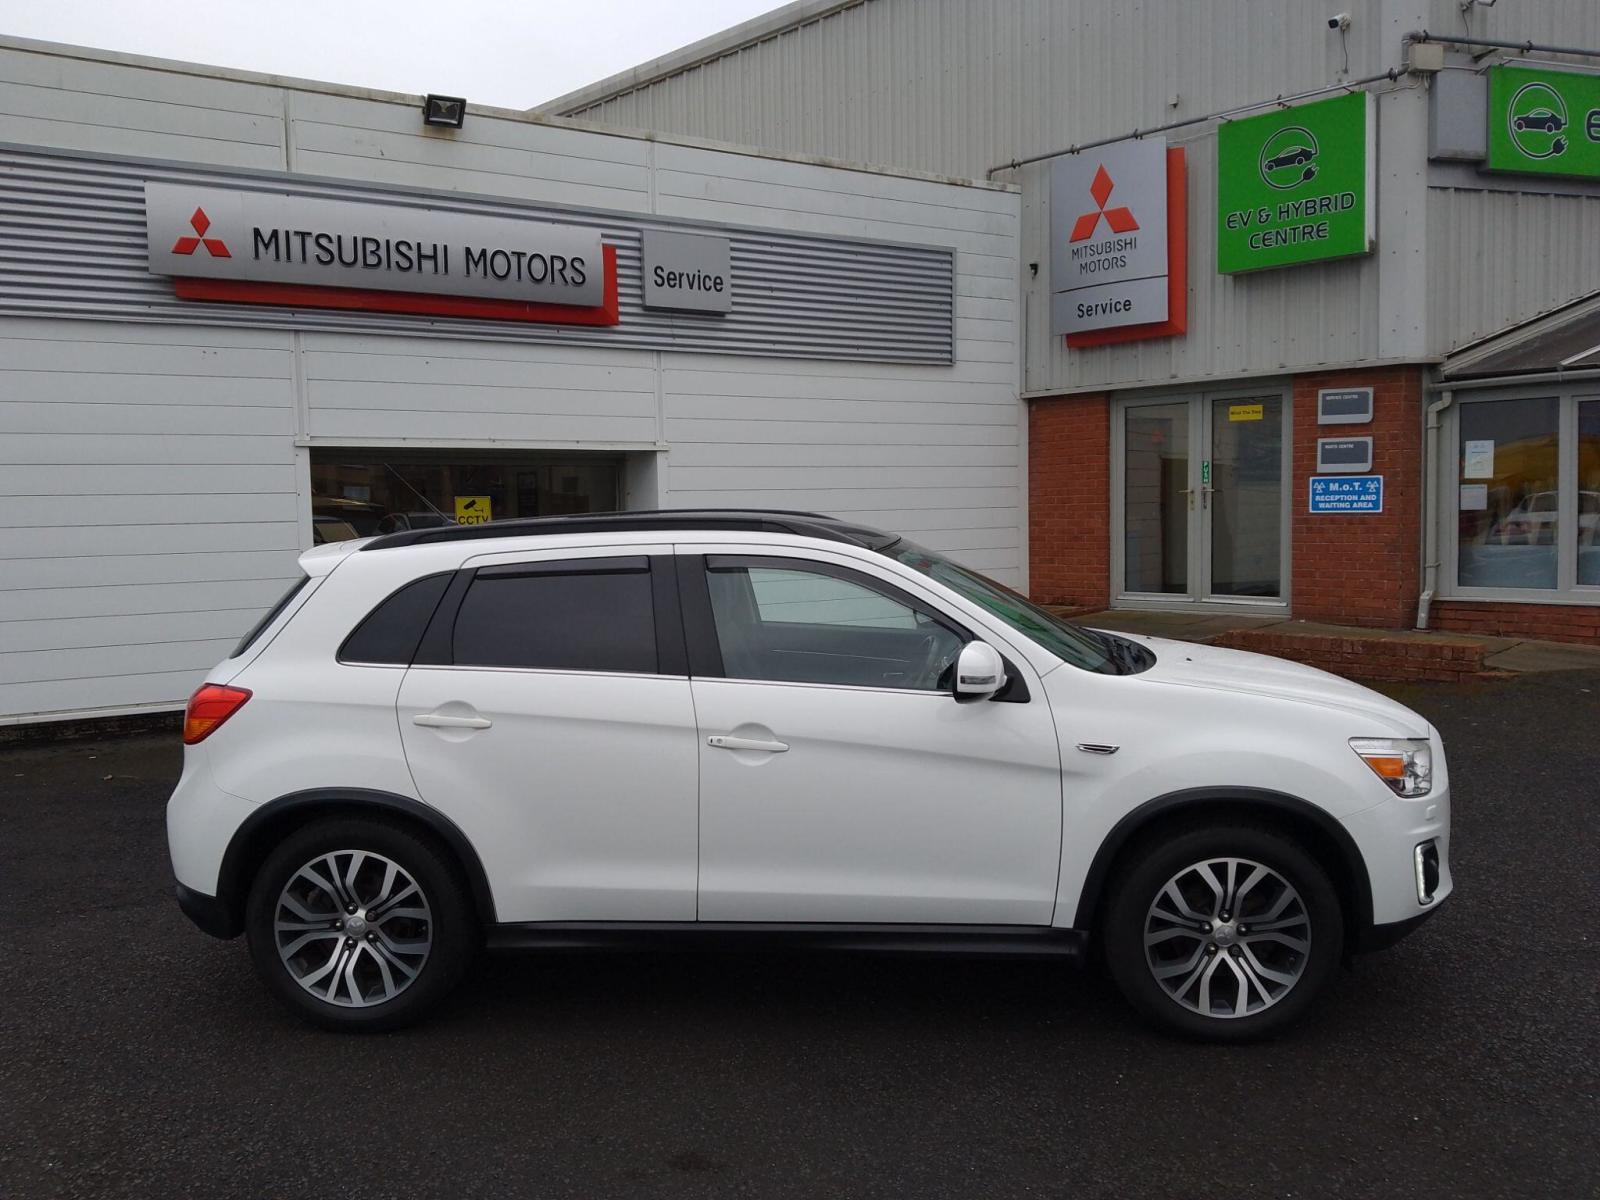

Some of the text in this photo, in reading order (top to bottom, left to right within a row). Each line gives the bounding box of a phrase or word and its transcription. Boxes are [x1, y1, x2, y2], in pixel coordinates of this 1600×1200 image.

[1226, 192, 1355, 229] EV & HYBRID
[1249, 222, 1328, 249] CENTRE
[253, 227, 587, 285] MITSUBISHI MOTORS
[1071, 237, 1137, 261] MITSUBISHI
[1080, 255, 1127, 275] MOTORS
[653, 265, 724, 293] Service
[1077, 298, 1132, 319] Service
[1329, 482, 1363, 491] M.o.T.
[1315, 494, 1359, 502] RECEPTION
[457, 515, 489, 525] CCTV
